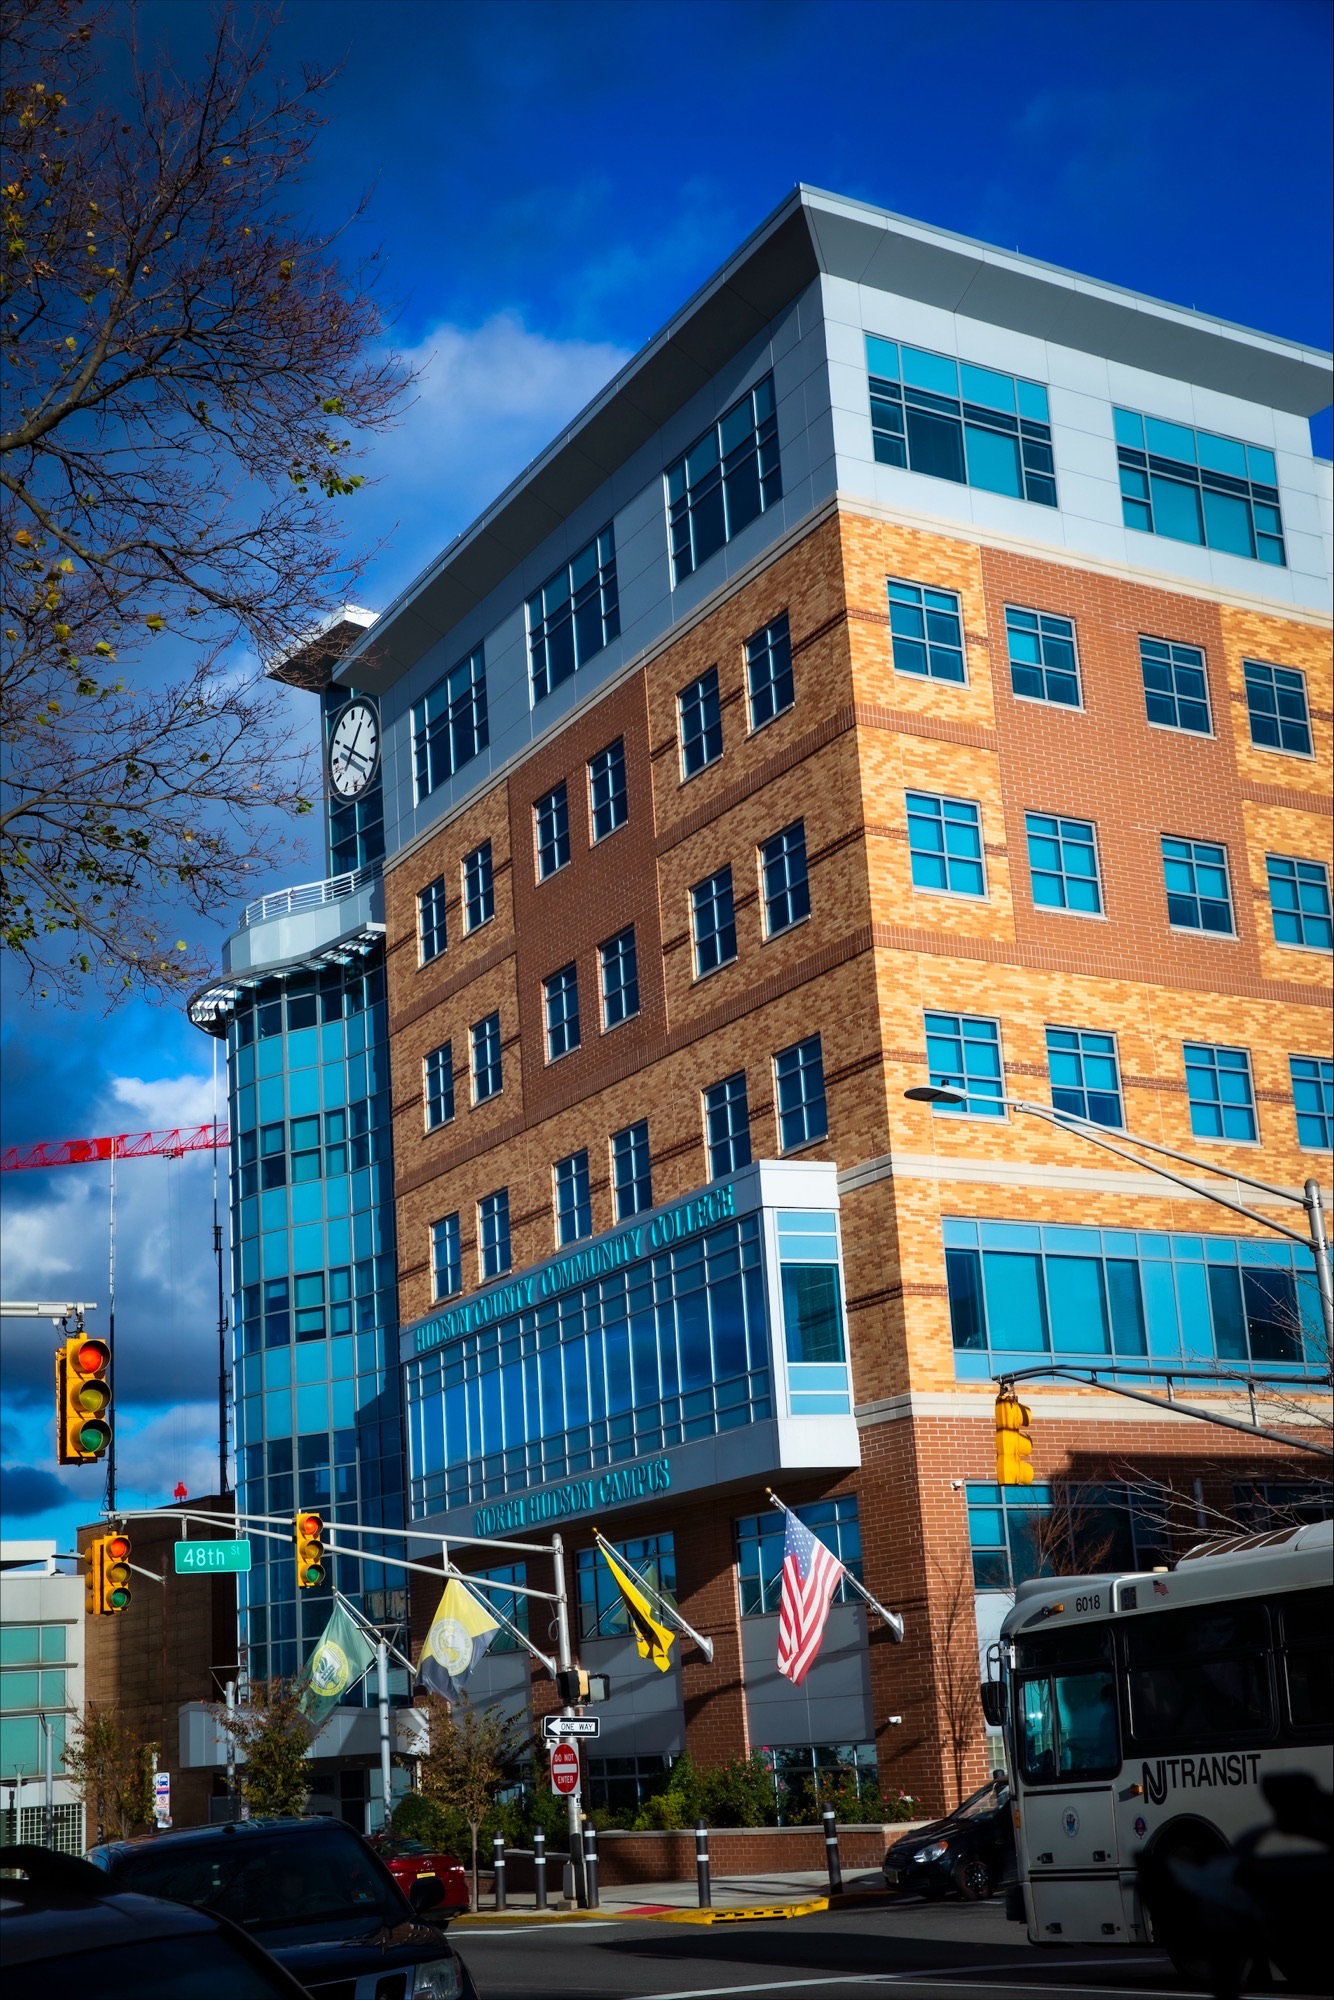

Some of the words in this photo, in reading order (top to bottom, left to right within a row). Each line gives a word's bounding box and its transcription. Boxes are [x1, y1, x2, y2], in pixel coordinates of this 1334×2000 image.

[416, 1311, 470, 1352] HUDSON
[474, 1276, 534, 1327] COUNTY
[541, 1226, 642, 1297] COMMUNITY
[651, 1184, 735, 1249] COLLEGE
[475, 1498, 526, 1537] NORTH
[530, 1479, 594, 1523] HUDSON
[599, 1458, 671, 1505] CAMPUS
[183, 1547, 225, 1567] 48th
[230, 1545, 240, 1556] St
[1075, 1594, 1101, 1613] 6018
[561, 1723, 575, 1731] ONE
[579, 1723, 594, 1731] WAY
[554, 1754, 562, 1762] DO
[564, 1753, 574, 1761] NOT
[558, 1776, 573, 1784] ENTER
[1168, 1754, 1262, 1789] TRANSIT
